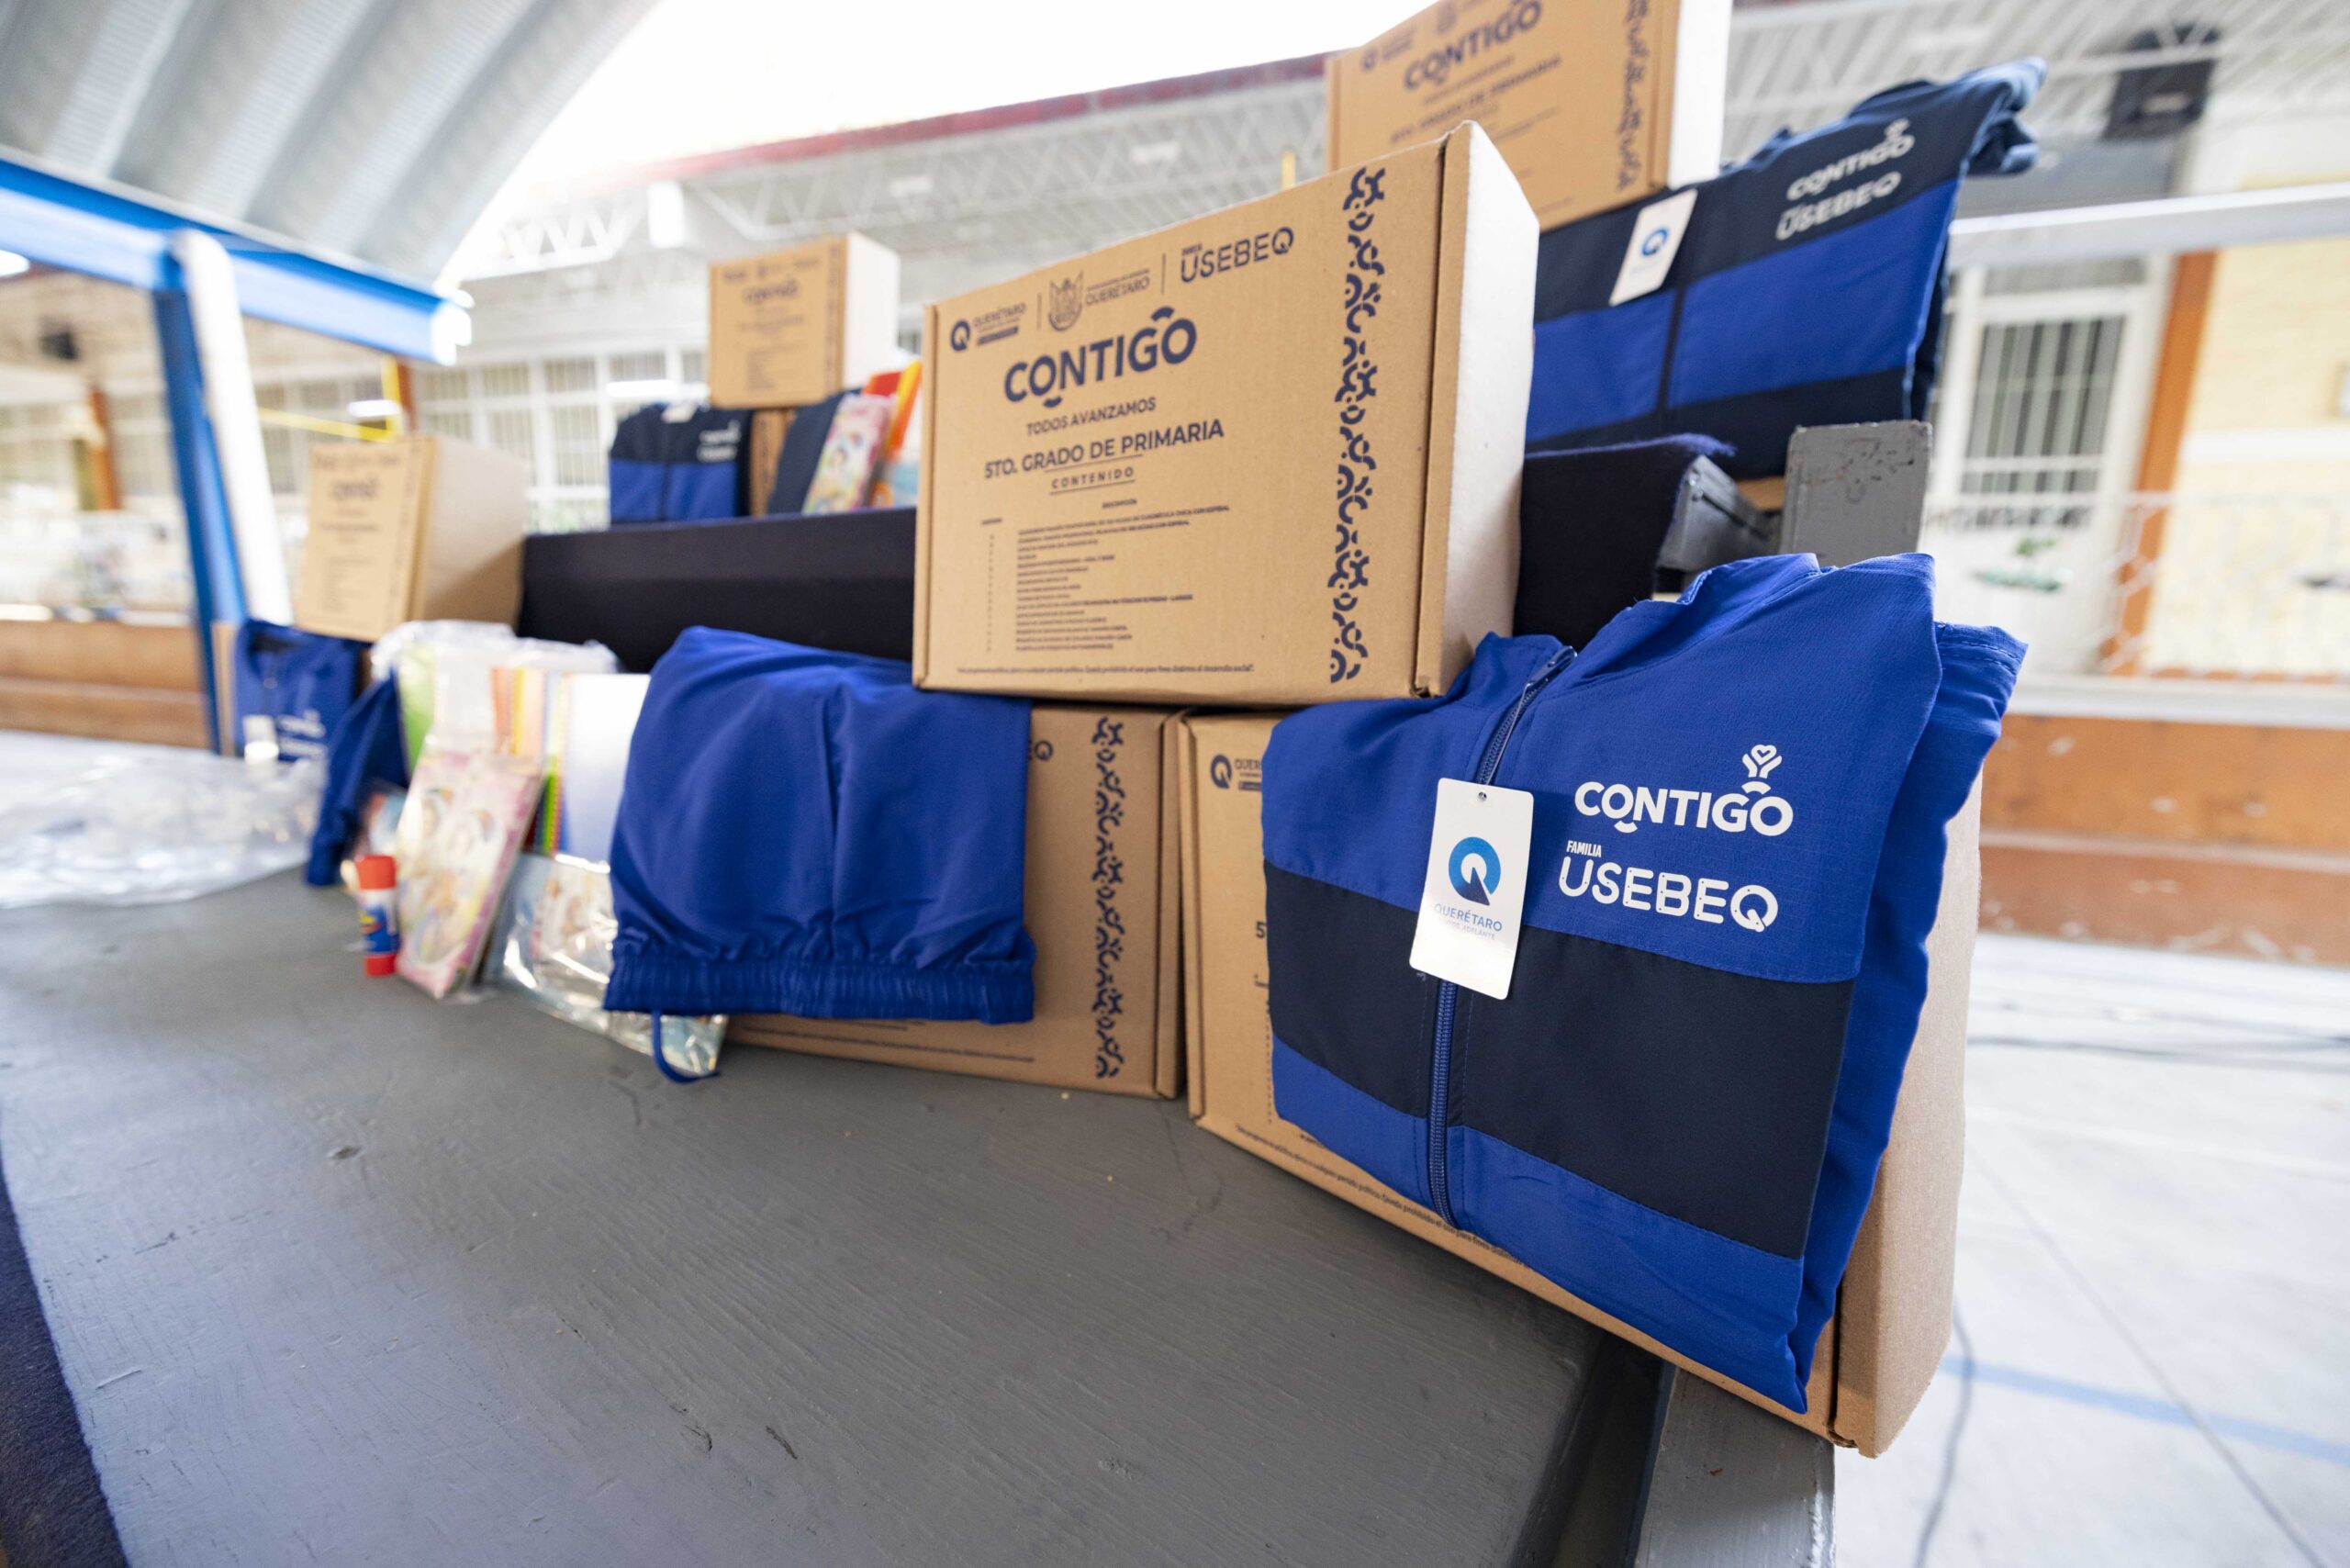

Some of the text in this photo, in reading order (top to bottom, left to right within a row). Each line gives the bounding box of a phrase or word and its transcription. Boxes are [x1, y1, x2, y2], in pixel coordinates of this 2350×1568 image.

[1786, 134, 1916, 201] CONTIGO
[1181, 227, 1294, 283] USEBEQ
[1004, 306, 1197, 409] CONTIGO
[1026, 397, 1157, 437] TODOS AVANZAMOS
[985, 419, 1225, 479] 5TO. GRADO DE PRIMARIA
[1052, 466, 1134, 489] CONTENIDO
[1574, 780, 1794, 837] CONTIGO
[1566, 840, 1602, 857] FAMILIA
[1434, 903, 1503, 932] QUERÉTARO
[1559, 856, 1779, 933] USEBEQ
